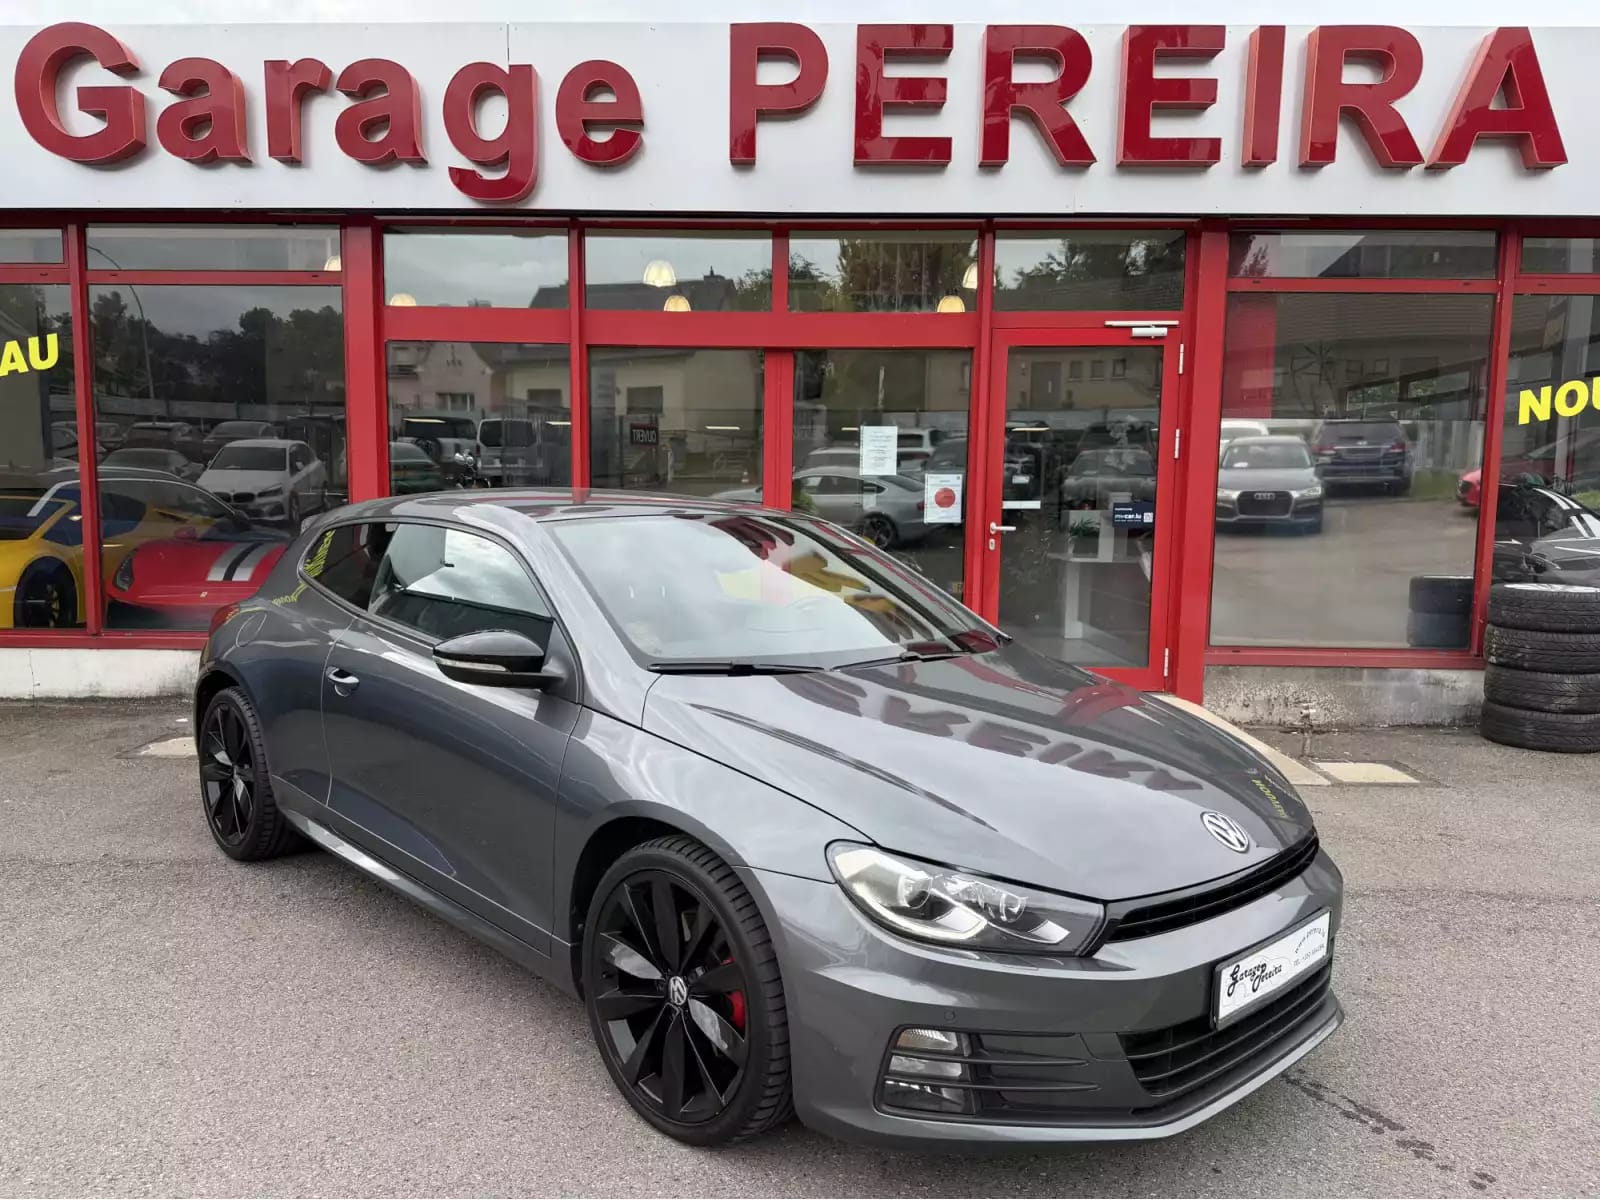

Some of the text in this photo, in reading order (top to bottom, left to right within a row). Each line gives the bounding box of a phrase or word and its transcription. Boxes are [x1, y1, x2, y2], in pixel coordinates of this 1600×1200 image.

[15, 22, 1568, 202] Garage PEREIRA
[1518, 376, 1600, 425] NO
